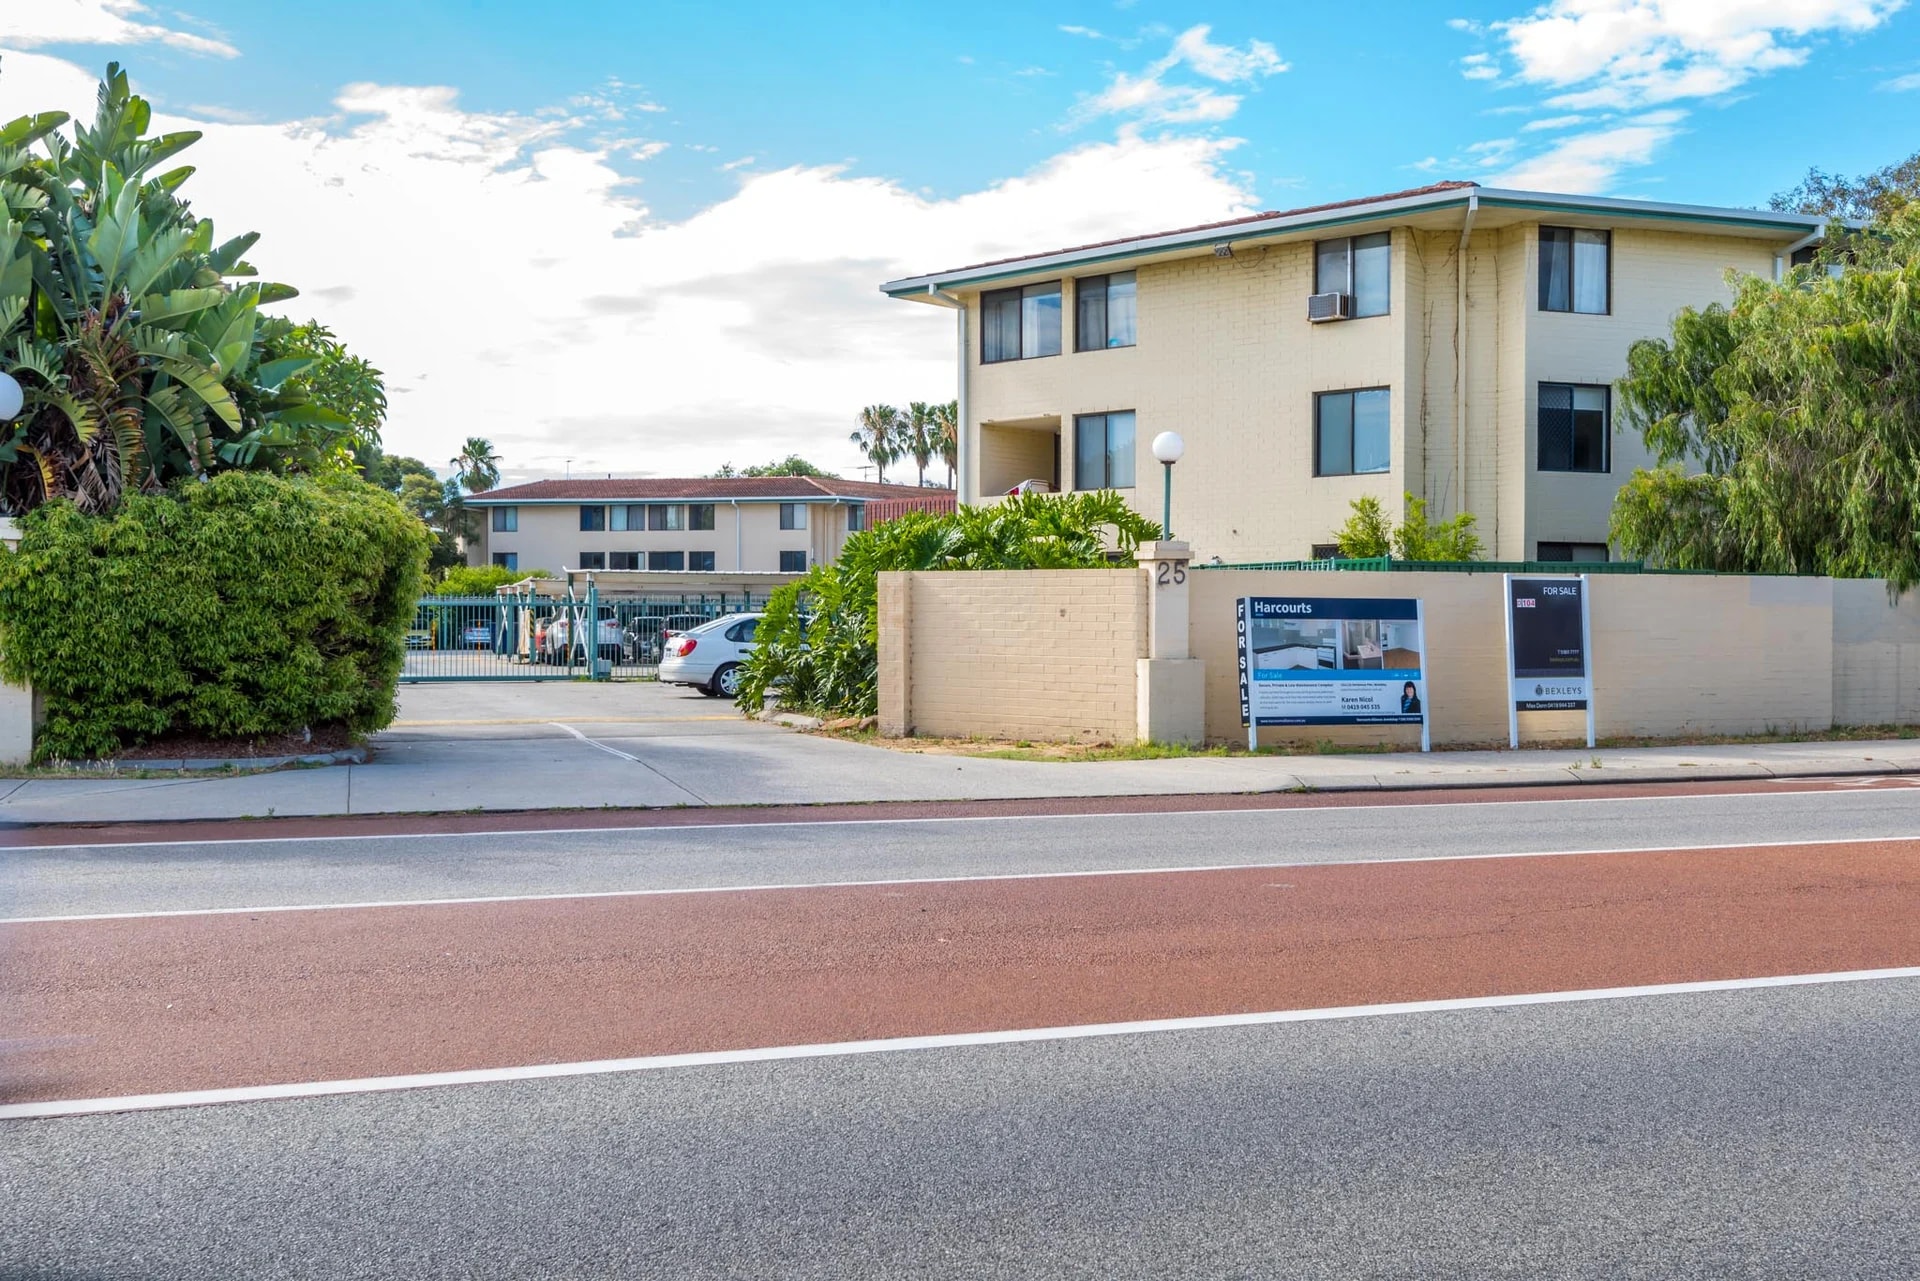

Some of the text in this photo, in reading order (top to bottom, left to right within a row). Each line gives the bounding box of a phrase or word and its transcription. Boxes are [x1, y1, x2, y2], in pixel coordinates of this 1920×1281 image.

[1158, 561, 1186, 585] 25
[1543, 587, 1577, 595] FOR SALE
[1254, 601, 1313, 614] Harcourts
[1237, 604, 1250, 717] FOR SALE
[1257, 671, 1283, 679] For Sale
[1545, 687, 1582, 695] BEXLEYS
